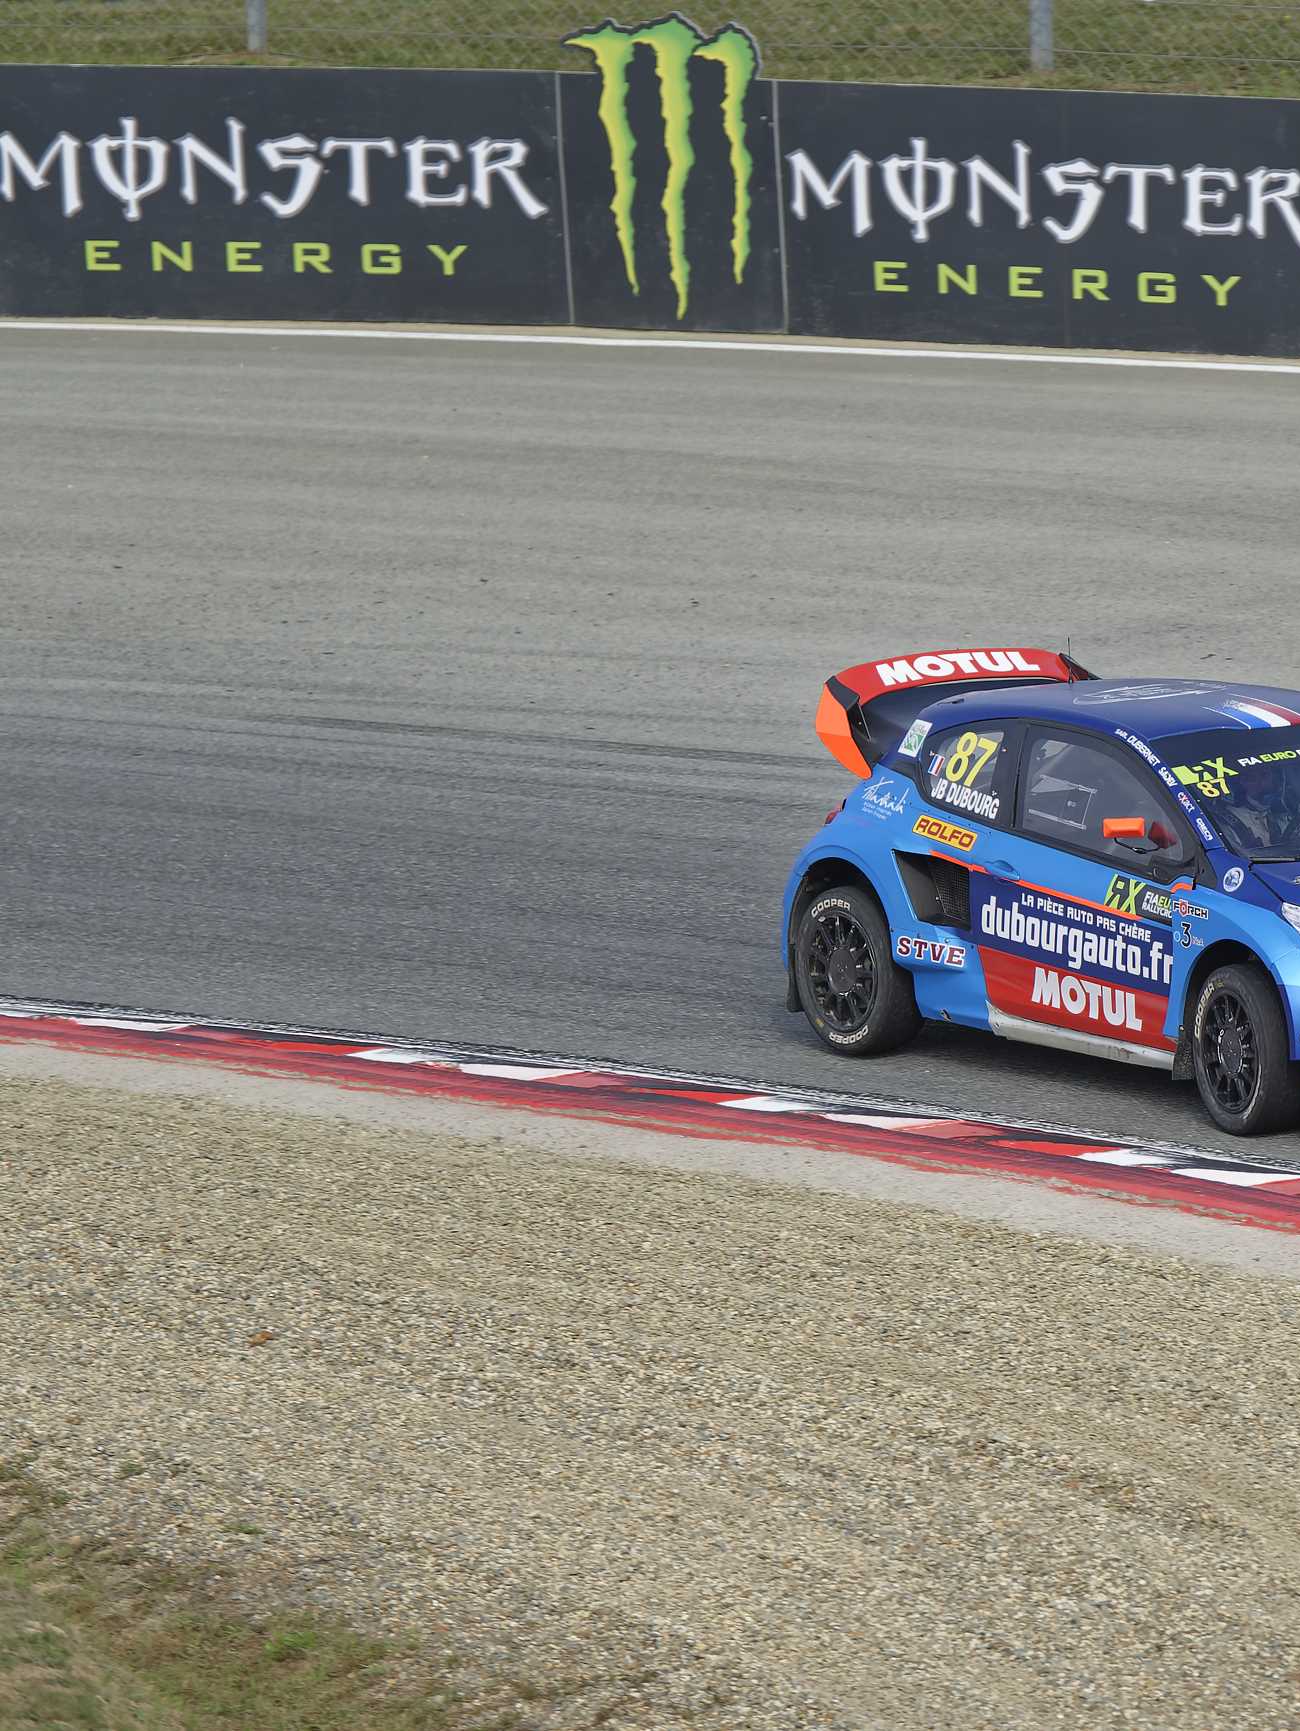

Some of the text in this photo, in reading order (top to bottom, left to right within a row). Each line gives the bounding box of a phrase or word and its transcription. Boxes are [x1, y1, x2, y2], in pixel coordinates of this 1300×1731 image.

[0, 118, 549, 222] MONSTER
[84, 239, 468, 276] ENERGY
[873, 261, 1242, 306] ENERGY
[875, 651, 1041, 687] MOTUL
[945, 731, 999, 787] 87
[1126, 735, 1160, 767] DUBERNET
[1237, 757, 1262, 767] FIA
[1261, 750, 1297, 763] EURO
[930, 777, 948, 800] JB
[948, 782, 1000, 820] DUBOURG
[1197, 778, 1231, 798] 87
[914, 817, 974, 848] ROLFO
[811, 898, 851, 918] COOPER
[1021, 892, 1034, 906] LA
[1066, 906, 1093, 925] AUTO
[1096, 916, 1116, 933] PAS
[898, 936, 966, 967] STVE
[981, 895, 1174, 984] dubourgauto.fr
[1031, 967, 1143, 1031] MOTUL
[1194, 982, 1214, 1039] COOPER
[828, 1024, 869, 1045] COOPER
